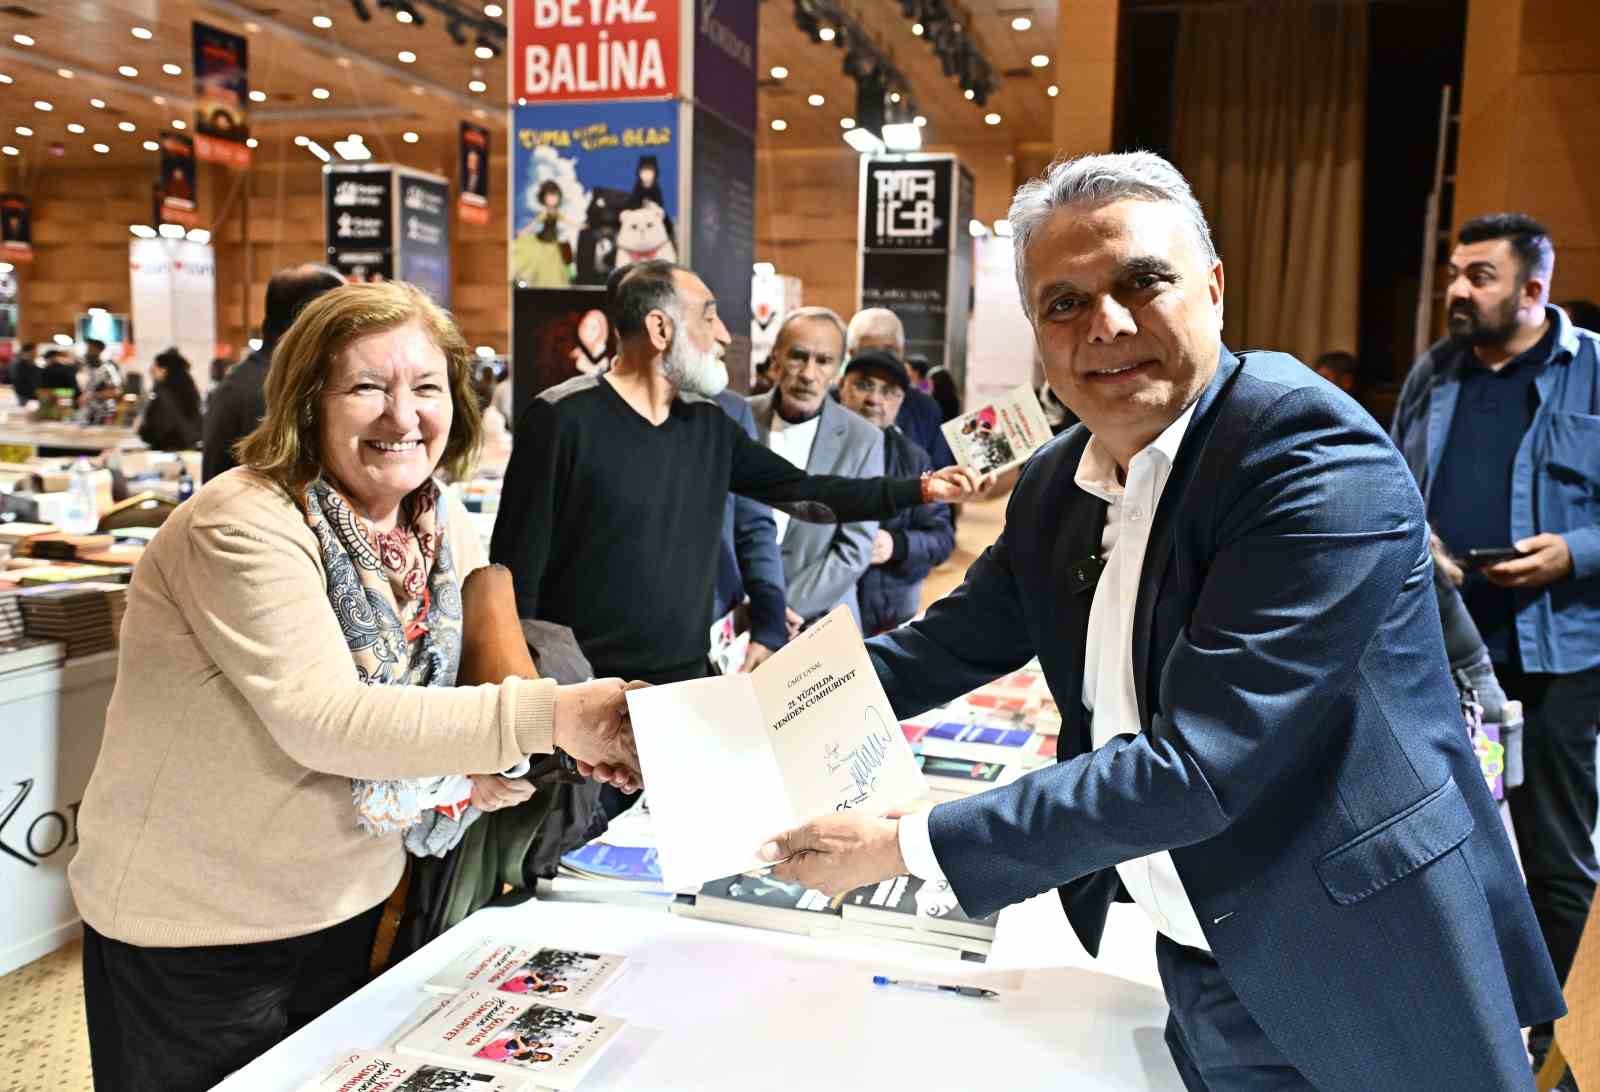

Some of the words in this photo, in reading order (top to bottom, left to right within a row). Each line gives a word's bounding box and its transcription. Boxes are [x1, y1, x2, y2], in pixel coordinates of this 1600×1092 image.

[525, 30, 667, 94] BALİNA
[772, 703, 805, 731] YENİDEN
[804, 668, 857, 709] CUMHURİYET
